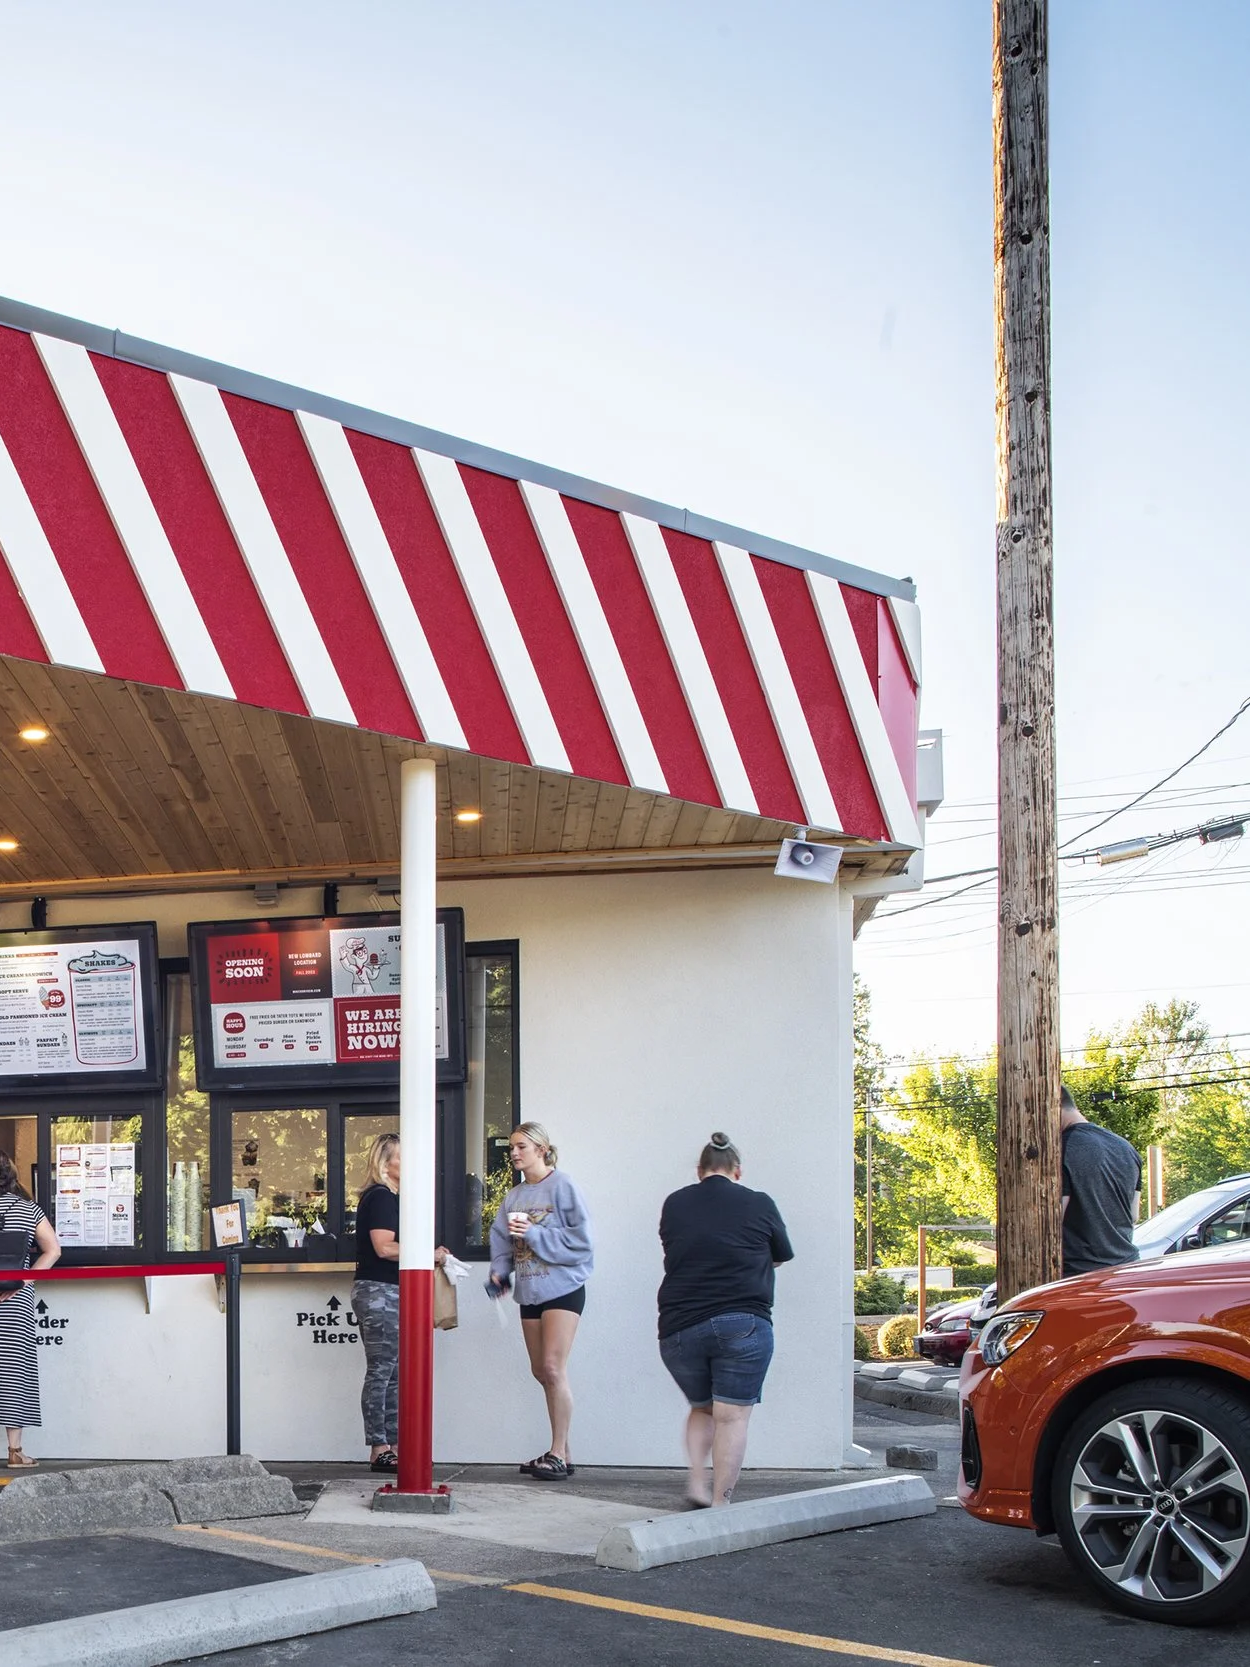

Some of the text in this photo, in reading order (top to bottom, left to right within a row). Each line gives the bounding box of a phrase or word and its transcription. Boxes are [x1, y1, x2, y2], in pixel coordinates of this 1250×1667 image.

[225, 958, 264, 967] OPENING
[225, 966, 264, 978] SOON
[345, 1010, 370, 1021] WE
[347, 1021, 401, 1034] HIRING
[34, 1315, 69, 1329] der
[296, 1312, 359, 1326] Pick U
[36, 1336, 63, 1346] ere
[313, 1330, 358, 1344] Here
